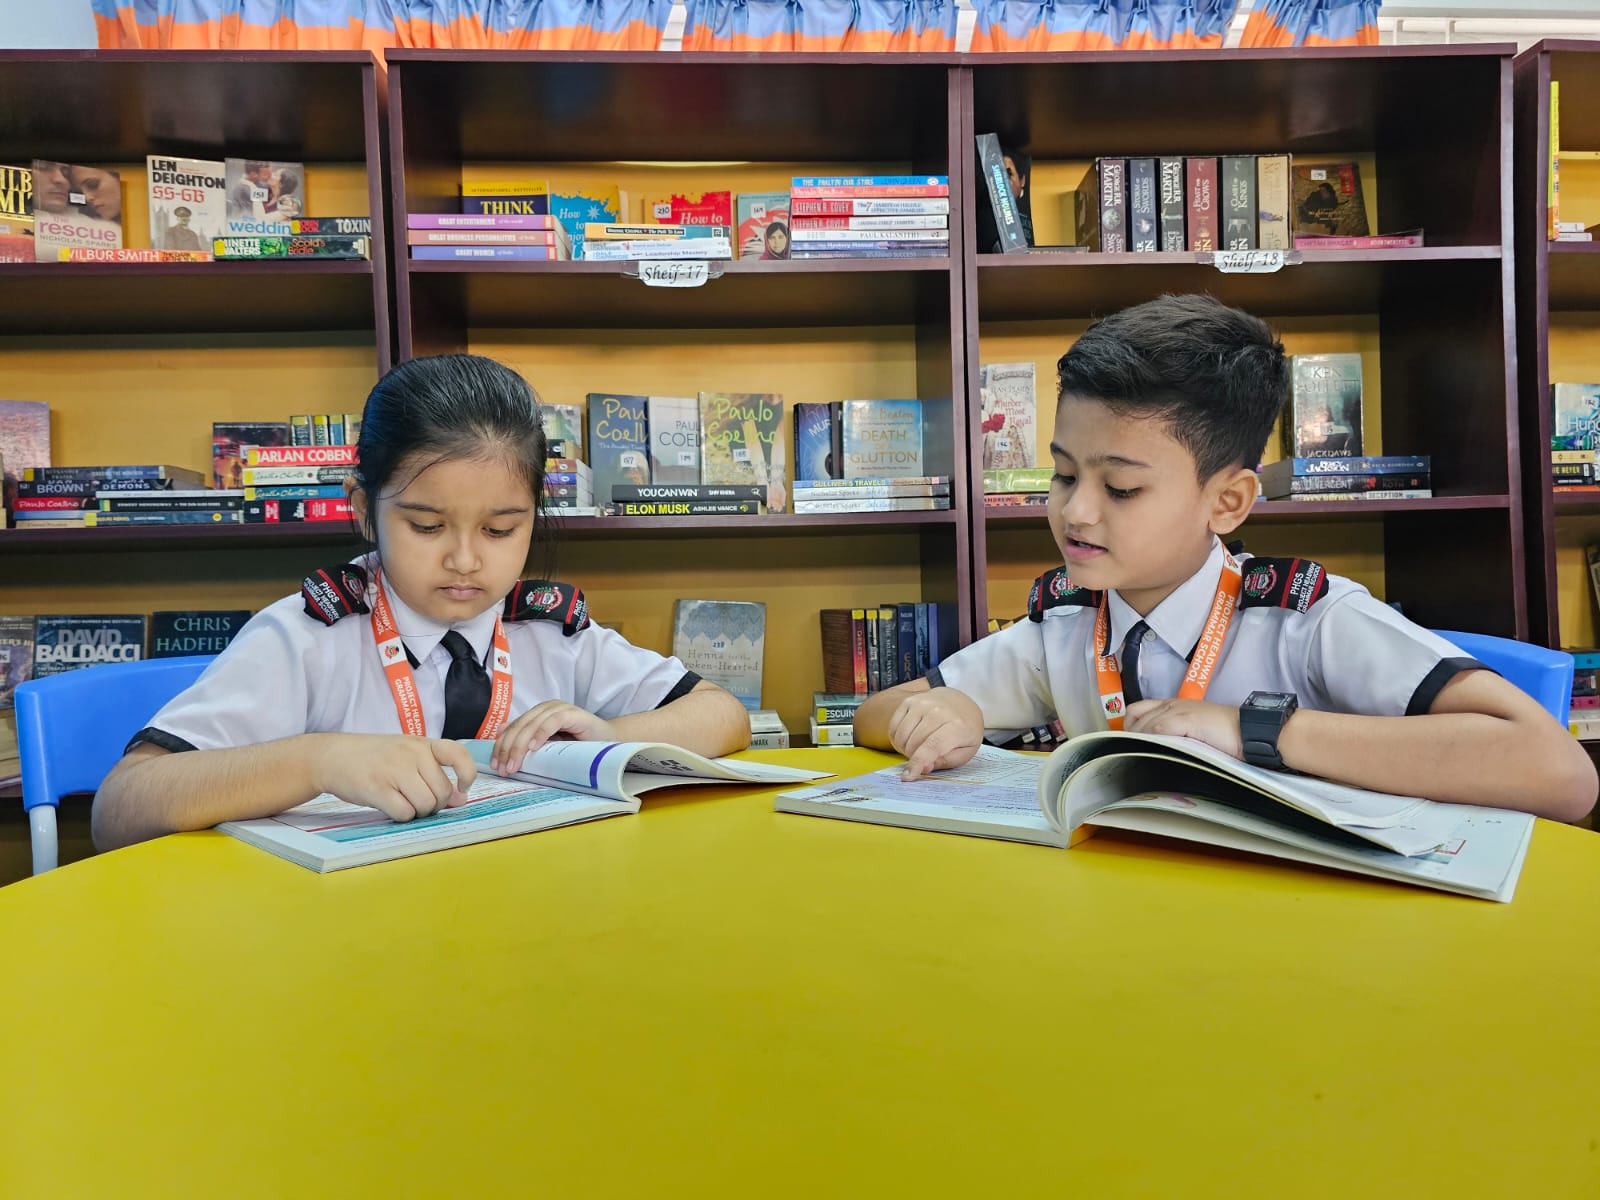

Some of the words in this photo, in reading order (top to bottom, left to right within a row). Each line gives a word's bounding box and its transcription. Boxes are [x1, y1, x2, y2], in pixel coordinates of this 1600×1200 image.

[152, 160, 177, 172] LEN
[0, 168, 32, 193] ILB
[152, 172, 226, 189] DEIGHTON
[1163, 162, 1173, 204] MARTIN
[1173, 162, 1181, 189] GEORGE
[1103, 164, 1113, 207] MARTIN
[1238, 180, 1248, 208] KINGS
[0, 190, 33, 214] MI
[992, 165, 1007, 196] SHERLOCK
[1000, 196, 1014, 225] HOLMES
[1141, 177, 1150, 213] SWORDS
[1200, 179, 1210, 210] CROWS
[480, 200, 535, 215] THINK
[559, 209, 580, 218] How
[797, 202, 821, 213] STEPHEN
[830, 202, 849, 212] COVEY
[865, 201, 872, 212] 7
[229, 220, 291, 235] weddin
[336, 219, 371, 233] TOXIN
[680, 213, 709, 225] How
[711, 213, 723, 224] to
[795, 218, 818, 229] STEPHEN
[39, 221, 117, 241] rescue
[40, 234, 82, 245] NICHOLAS
[86, 239, 117, 248] SPARKS
[1107, 233, 1115, 252] SWO
[118, 251, 159, 262] SMITH
[1222, 252, 1278, 271] Shelf-18
[603, 399, 648, 420] Pau
[713, 397, 773, 422] Paulo
[994, 400, 1022, 408] Murder
[676, 420, 700, 431] PAUL
[659, 432, 700, 447] COEL
[861, 430, 906, 441] DEATH
[308, 450, 352, 462] COBEN
[851, 452, 917, 464] GLUTTON
[1306, 464, 1349, 473] JACKSON
[37, 483, 84, 494] BROWN
[626, 504, 655, 515] ELON
[659, 504, 690, 514] MUSK
[319, 581, 340, 603] PHGS
[1290, 572, 1304, 595] PHGS
[174, 617, 231, 632] CHRIS
[1205, 590, 1225, 643] GRAMMAR
[1217, 594, 1235, 638] PROJECT
[58, 628, 122, 645] DAVID
[157, 637, 230, 652] HADFIEL
[37, 644, 140, 662] BALDACCI
[688, 650, 724, 659] Henna
[682, 660, 758, 671] roken-Hearted
[1186, 641, 1208, 683] SCHOOL
[1197, 637, 1222, 689] HEADWAY
[395, 679, 411, 718] GRAMMAR
[502, 681, 510, 709] SCHOOL
[402, 676, 417, 707] PROJECT
[412, 709, 423, 736] HEADW
[480, 714, 496, 738] ROJECT
[492, 679, 503, 714] HEADWAY
[826, 709, 855, 718] ESCUIN
